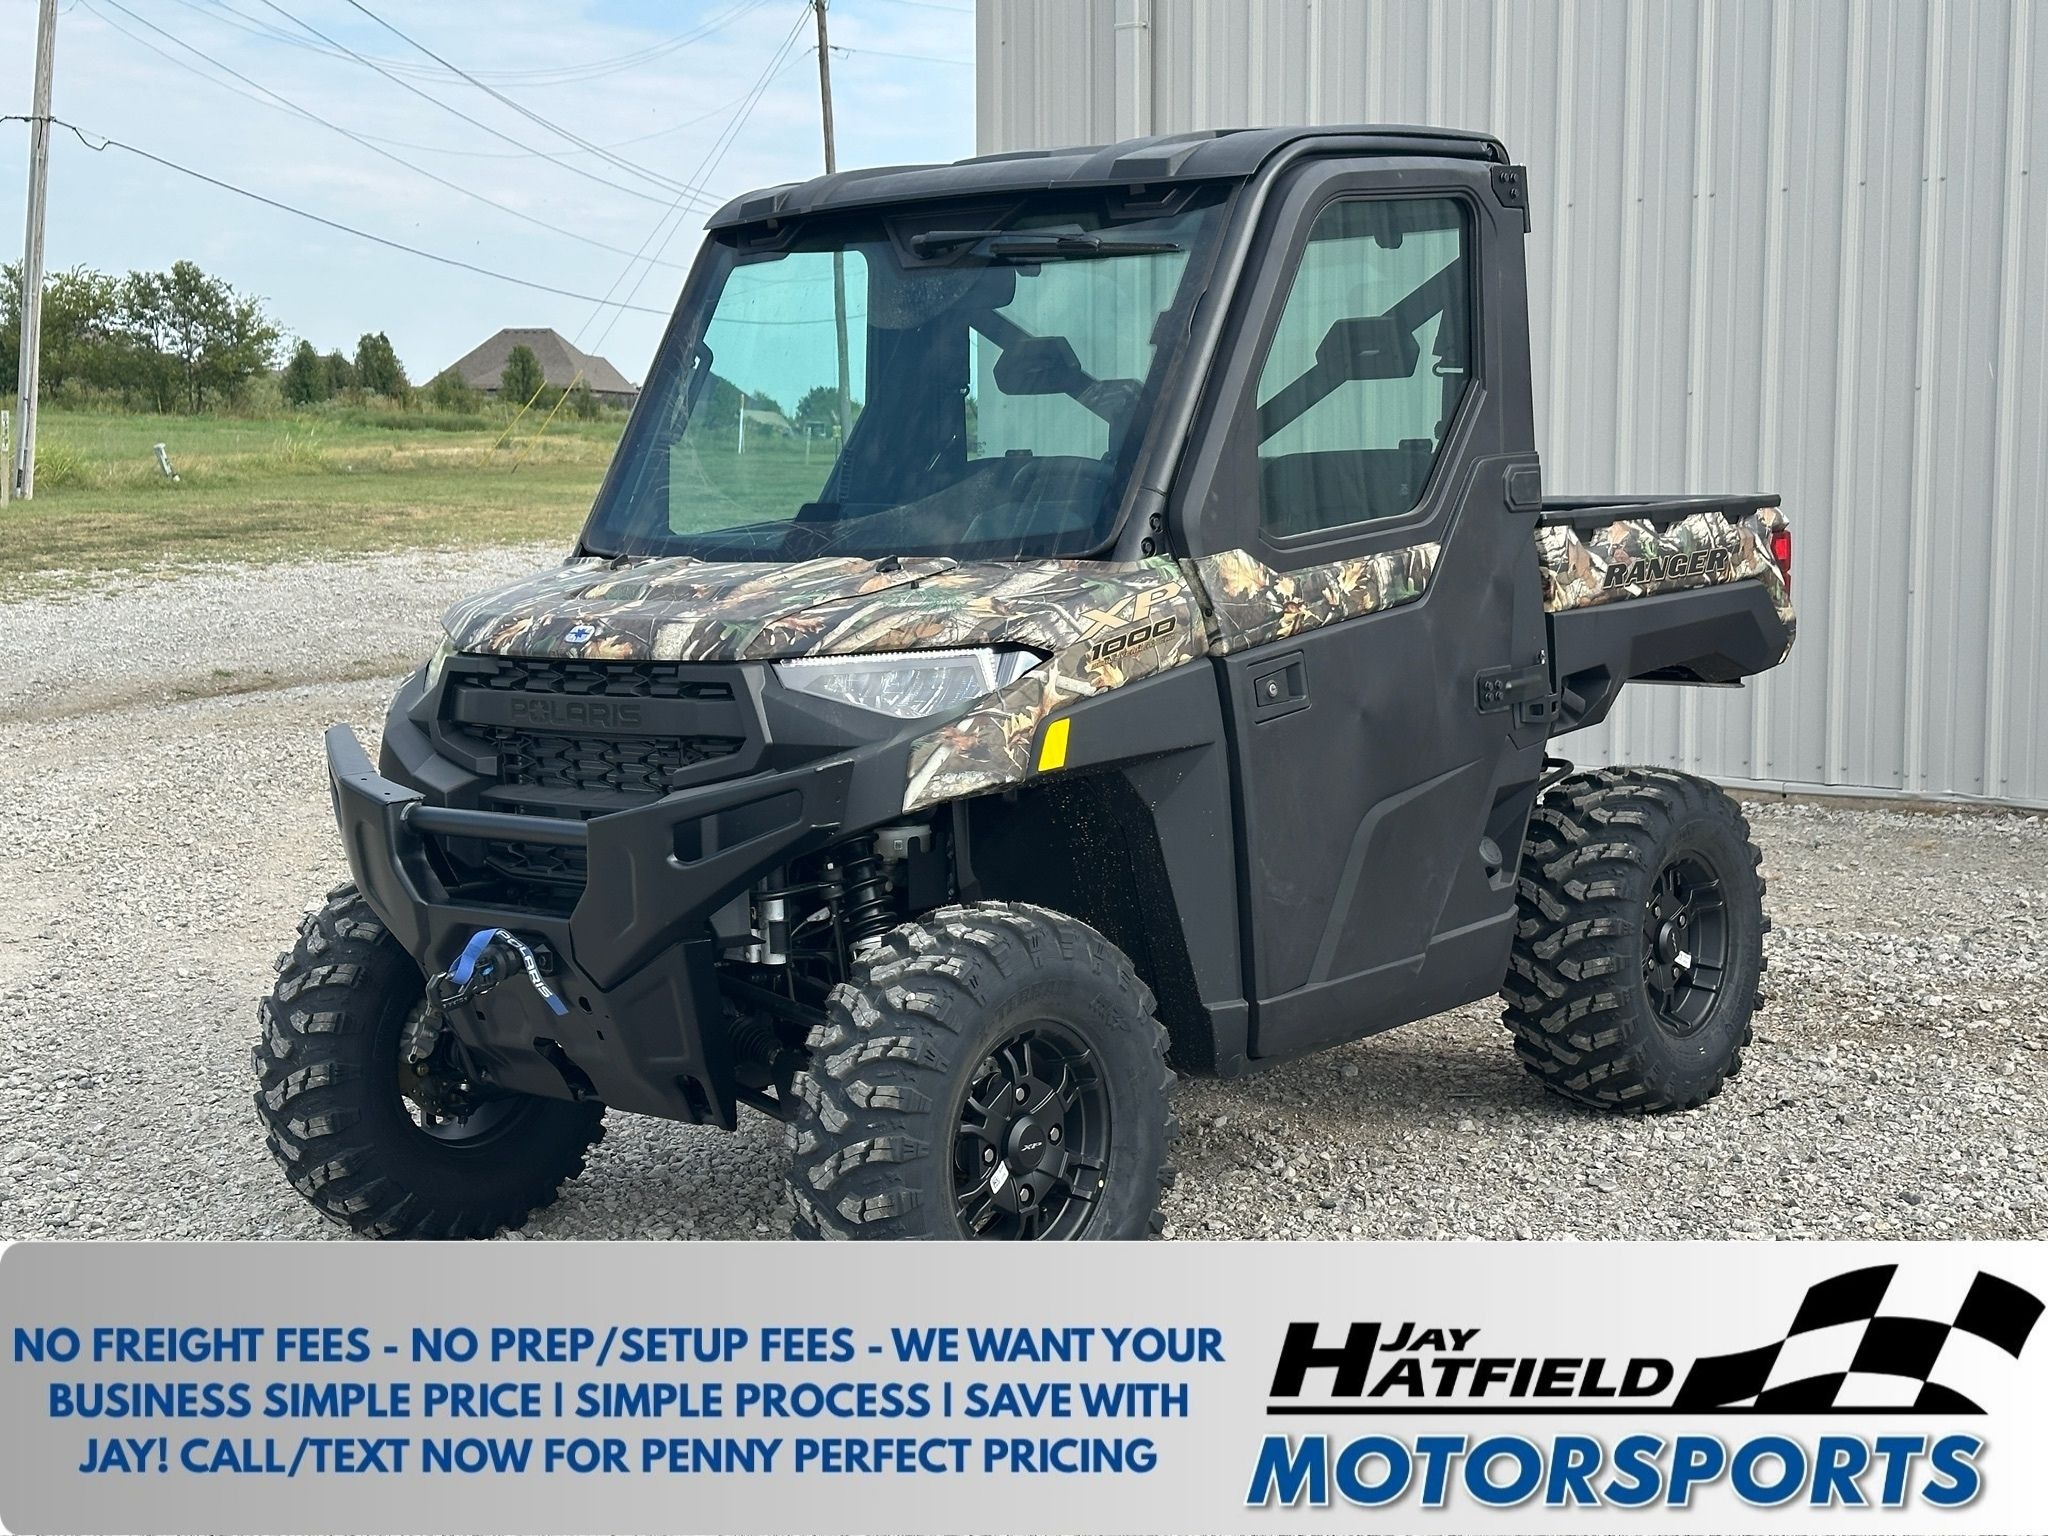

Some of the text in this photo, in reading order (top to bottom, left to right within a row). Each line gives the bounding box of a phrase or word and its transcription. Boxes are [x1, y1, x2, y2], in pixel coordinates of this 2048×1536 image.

[1603, 548, 1728, 590] RANGER
[1074, 581, 1182, 644] XP
[1091, 614, 1178, 661] 1000
[510, 699, 643, 729] POLARIS
[495, 929, 554, 998] POLARIS
